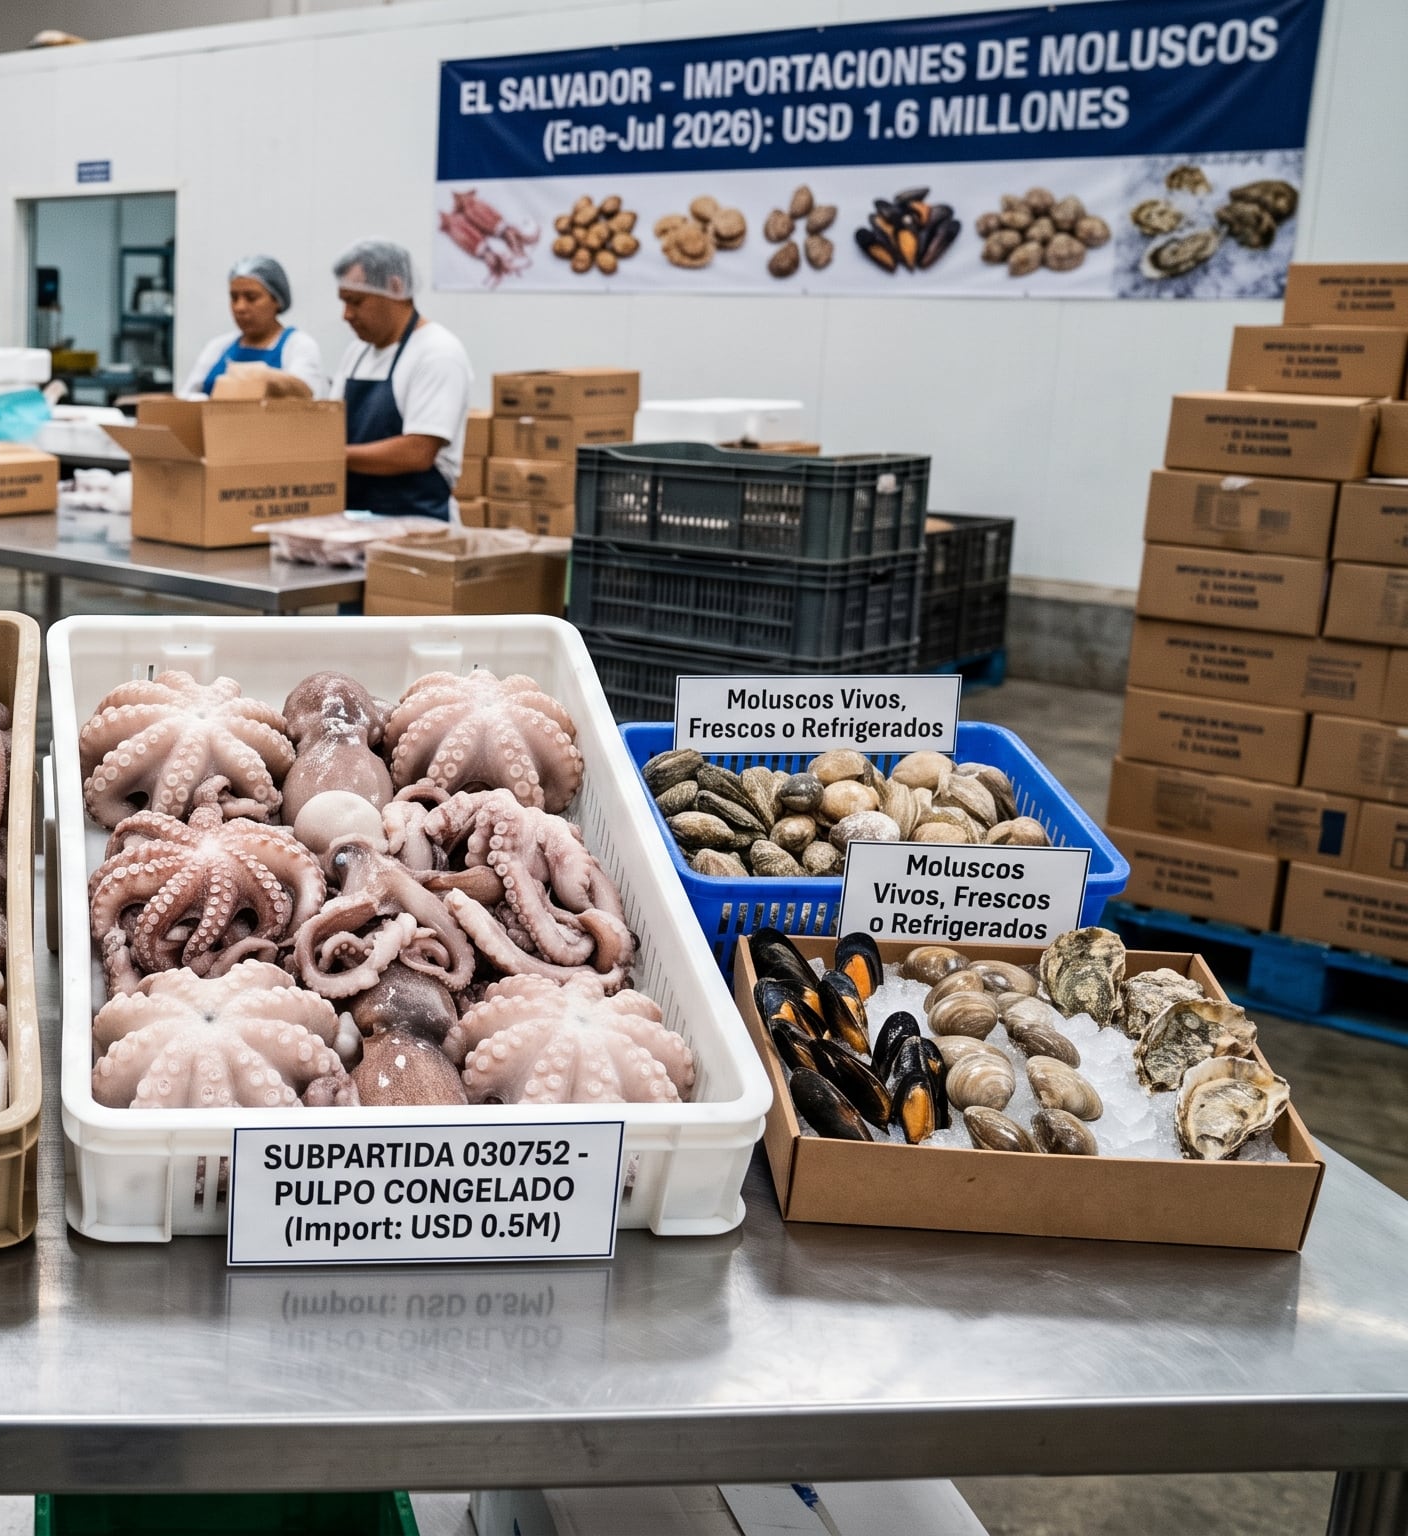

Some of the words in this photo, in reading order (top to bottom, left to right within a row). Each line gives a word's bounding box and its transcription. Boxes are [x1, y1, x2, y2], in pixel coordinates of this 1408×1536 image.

[459, 80, 494, 115] EL
[498, 67, 652, 112] SALVADOR
[683, 42, 966, 100] IMPORTACIONES
[976, 37, 1029, 81] DE
[1039, 16, 1279, 76] MOLUSCOS
[543, 114, 665, 161] (Ene-Jul
[672, 108, 774, 154] 2026):
[782, 103, 853, 144] USD
[865, 99, 919, 140] 1.6
[929, 86, 1129, 137] MILLONES
[727, 688, 834, 710] Moluscos
[840, 688, 907, 712] Vivos,
[689, 717, 776, 739] Frescos
[782, 722, 795, 739] o
[801, 717, 944, 744] Refrigerados
[906, 854, 1025, 880] Moluscos
[873, 882, 945, 910] Vivos,
[953, 885, 1051, 911] Frescos
[869, 916, 884, 933] o
[891, 912, 1048, 942] Refrigerados
[263, 1142, 455, 1170] SUBPARTIDA
[463, 1140, 570, 1167] 030752
[274, 1179, 375, 1206] PULPO
[383, 1176, 575, 1205] CONGELADO
[284, 1215, 402, 1247] (Import:
[411, 1213, 473, 1240] USD
[481, 1211, 561, 1243] 0.5M)
